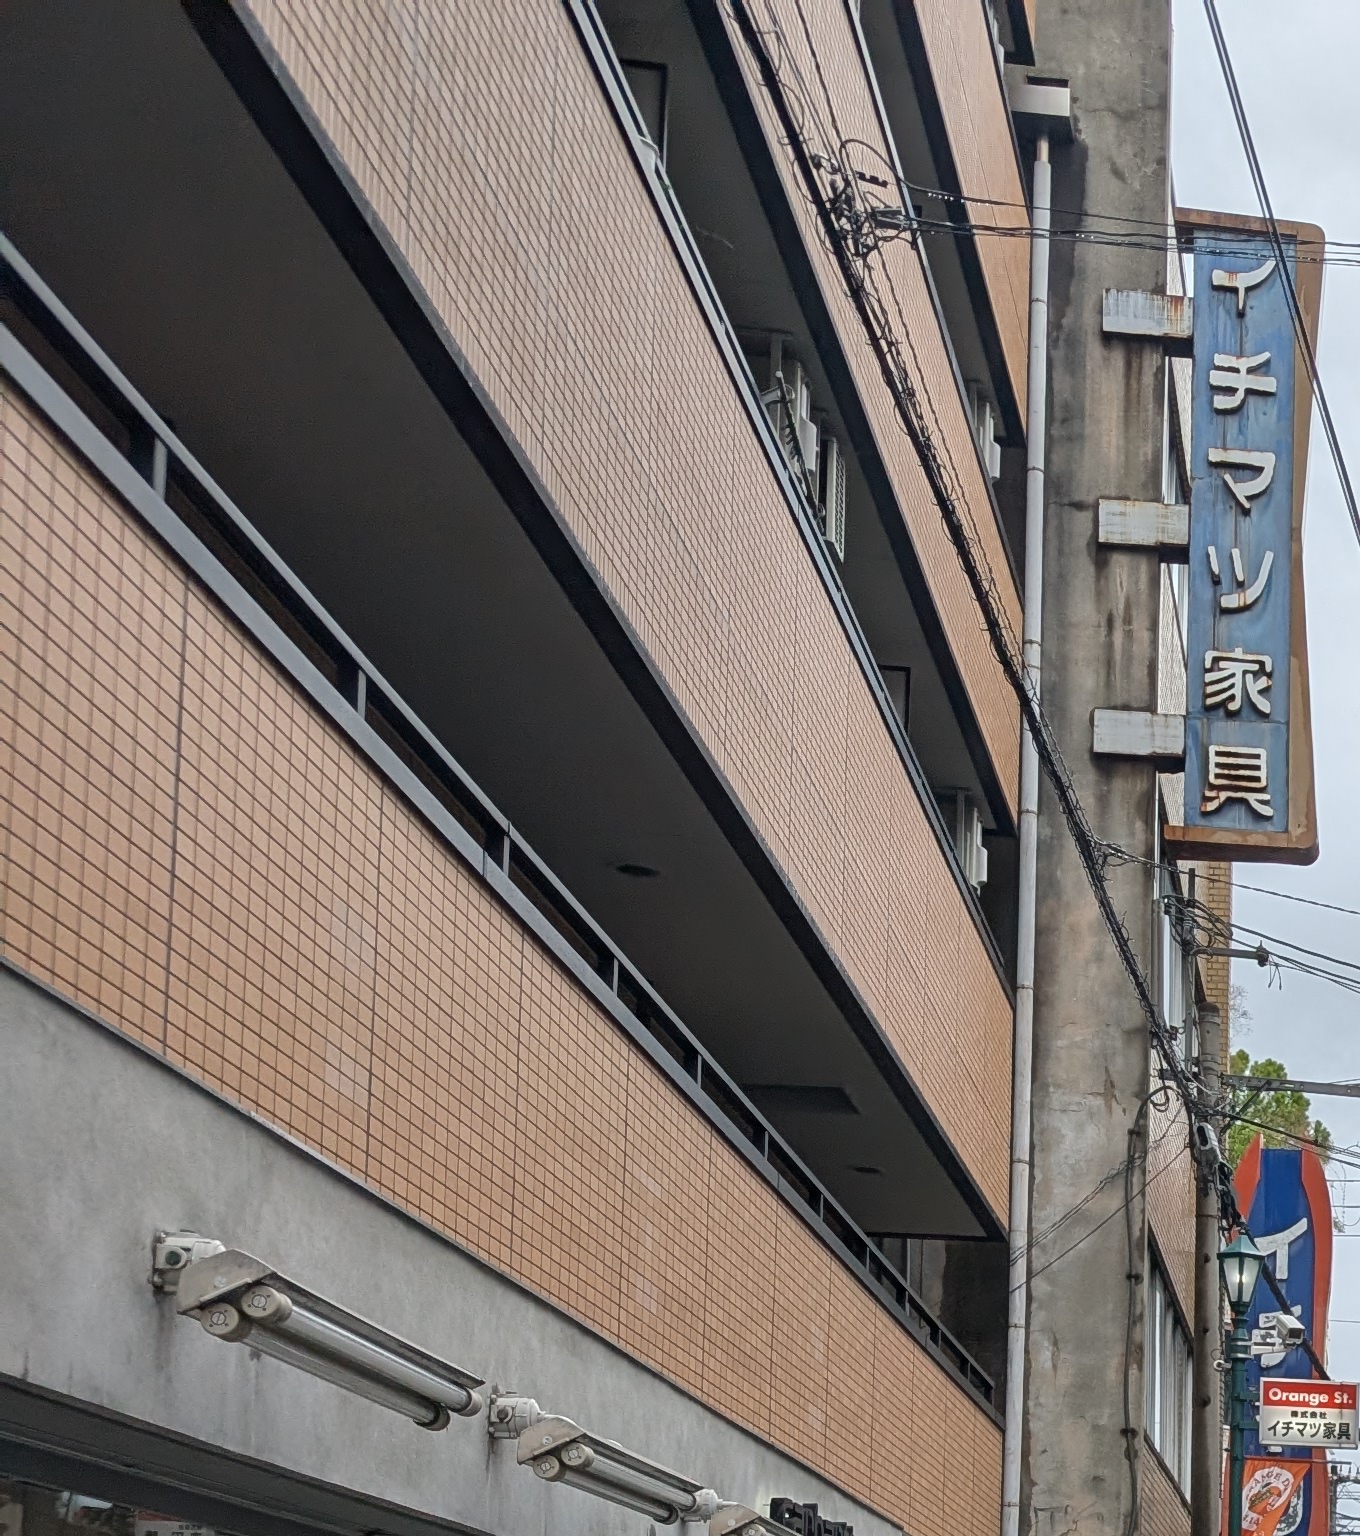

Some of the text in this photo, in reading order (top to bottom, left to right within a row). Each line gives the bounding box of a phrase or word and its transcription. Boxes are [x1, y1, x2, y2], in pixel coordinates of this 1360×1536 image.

[1203, 258, 1279, 820] イチマツ家具
[1268, 1387, 1353, 1406] Orange St.
[1290, 1410, 1328, 1420] 株式会社
[1267, 1420, 1351, 1440] イチマツ家具
